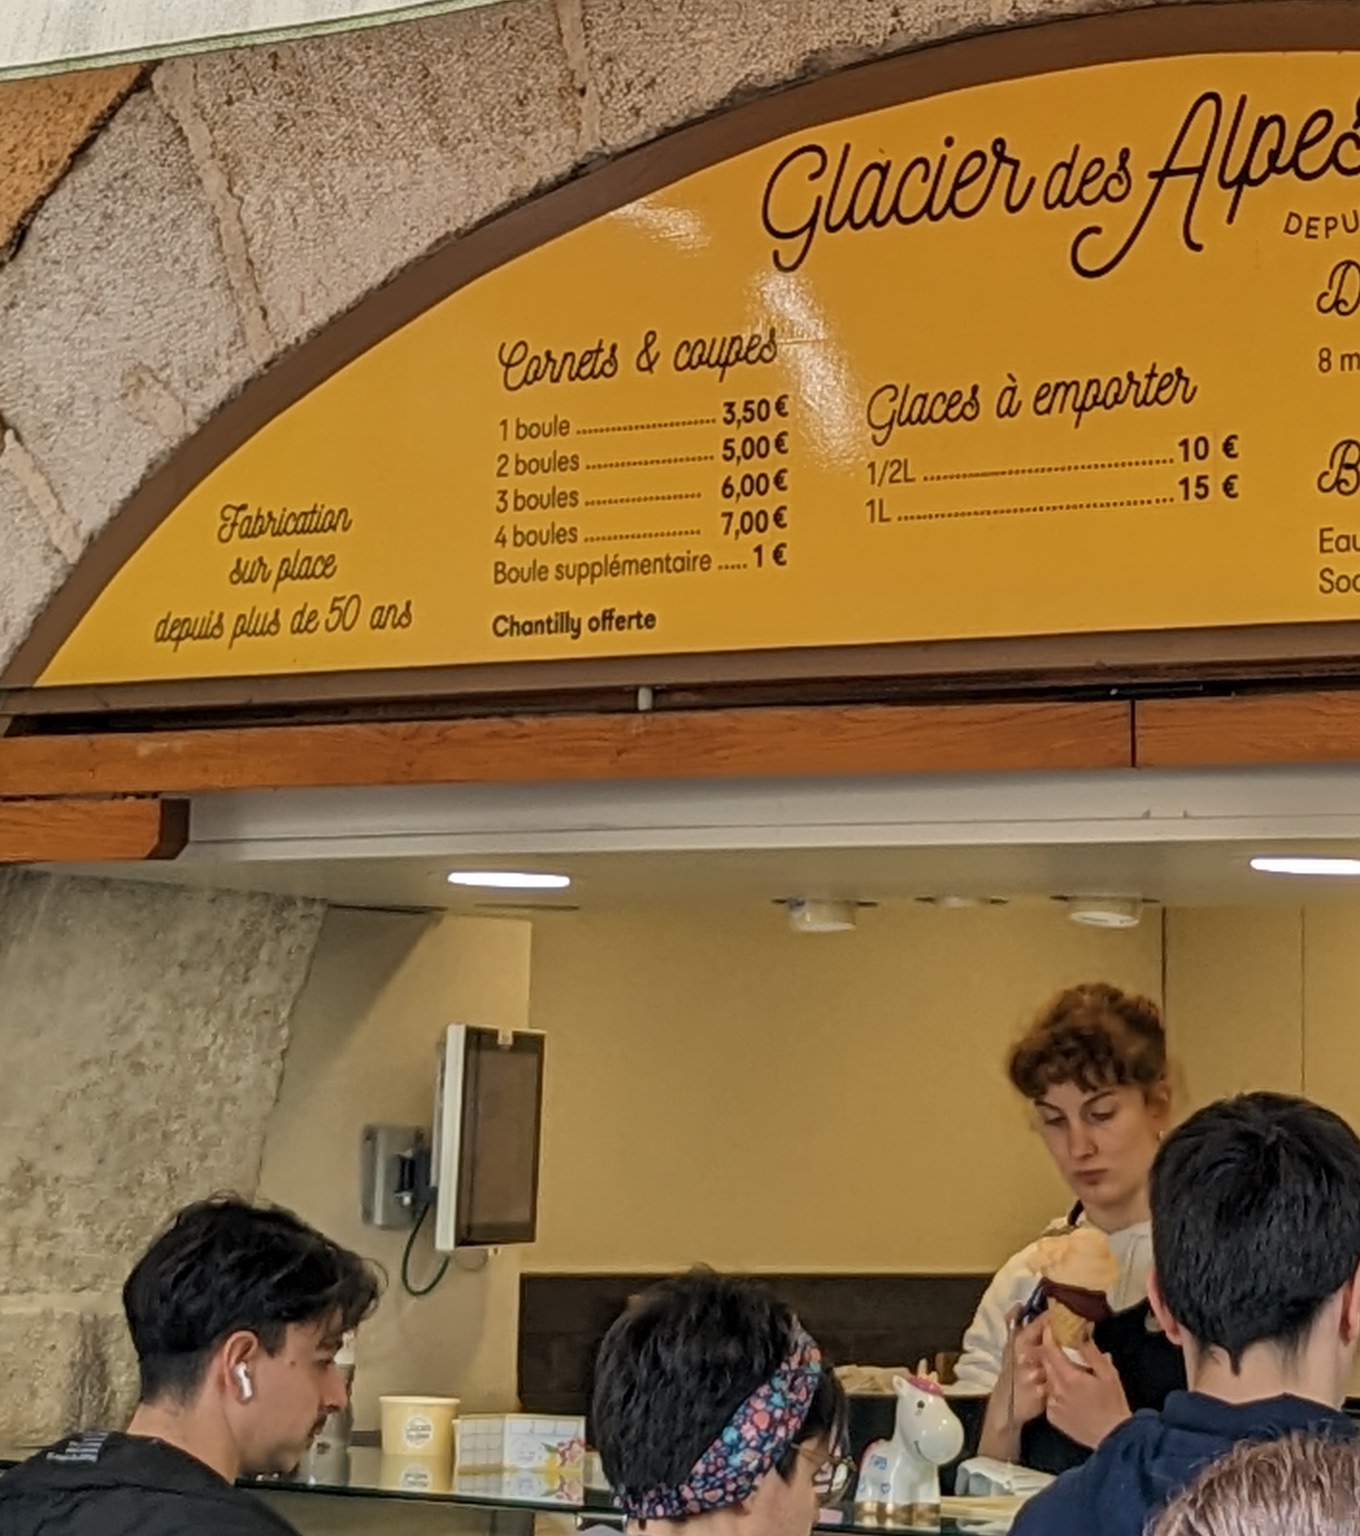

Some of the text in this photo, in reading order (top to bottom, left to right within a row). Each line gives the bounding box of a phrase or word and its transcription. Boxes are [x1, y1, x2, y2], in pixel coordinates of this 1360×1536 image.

[762, 136, 1036, 272] Glacier
[1043, 144, 1132, 209] des
[499, 327, 777, 391] Cornets & coupes
[1318, 347, 1333, 373] 8
[499, 419, 509, 441] 1
[515, 414, 570, 440] boule
[722, 399, 770, 430] 3,50
[867, 362, 1198, 447] Glaces à emporter
[496, 454, 509, 477] 2
[514, 450, 580, 476] boules
[722, 435, 770, 466] 5,00
[867, 434, 1239, 487] 1/2L 10 €
[496, 490, 509, 513] 3
[514, 485, 579, 512] boules
[721, 473, 769, 503] 6,00
[866, 474, 1239, 524] 1L 15 €
[217, 503, 352, 543] Fabrication
[494, 525, 507, 548] 4
[513, 521, 578, 548] boules
[721, 510, 769, 541] 7,00
[229, 549, 338, 593] sur place
[494, 543, 787, 586] Boule supplémentaire 1 €
[154, 594, 413, 652] depuis plus de 50 ans
[492, 607, 657, 640] Chantilly offerte
